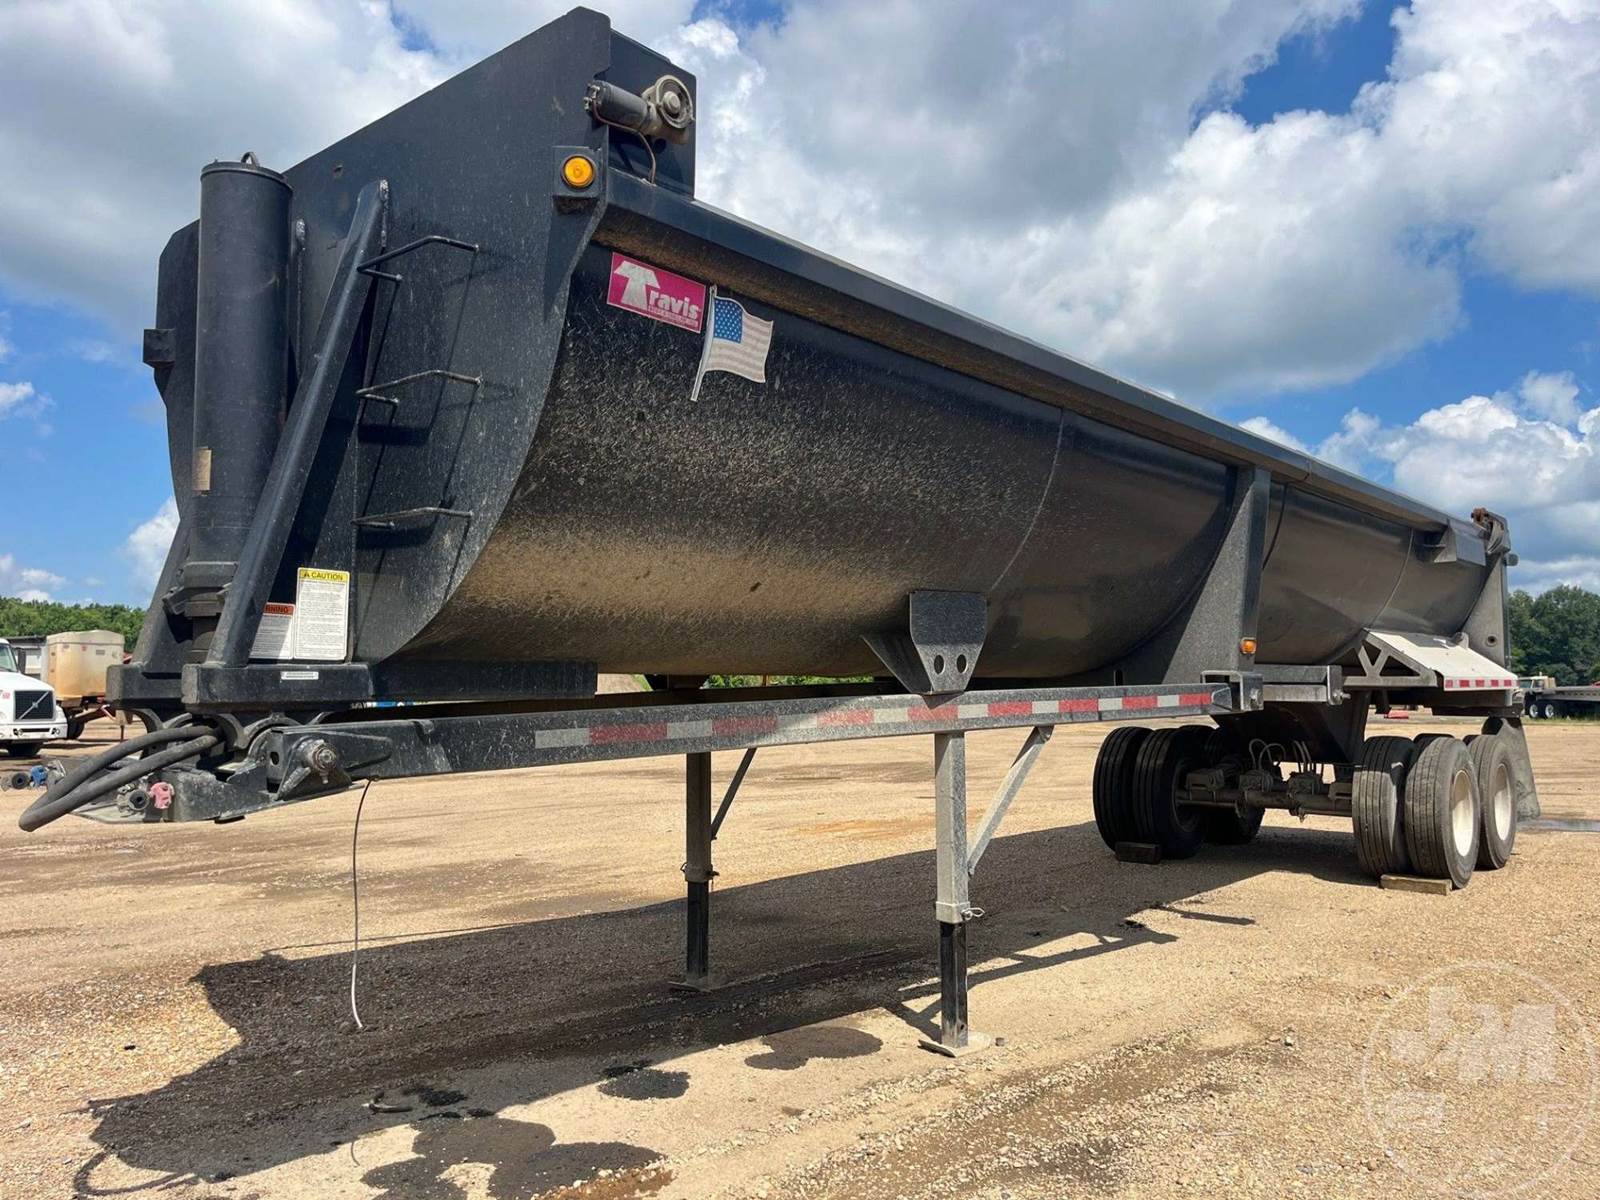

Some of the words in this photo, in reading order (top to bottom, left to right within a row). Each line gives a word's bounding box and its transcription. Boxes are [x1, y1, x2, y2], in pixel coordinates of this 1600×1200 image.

[614, 261, 700, 320] Travis
[311, 572, 343, 581] CAUTION
[265, 604, 289, 614] RNING
